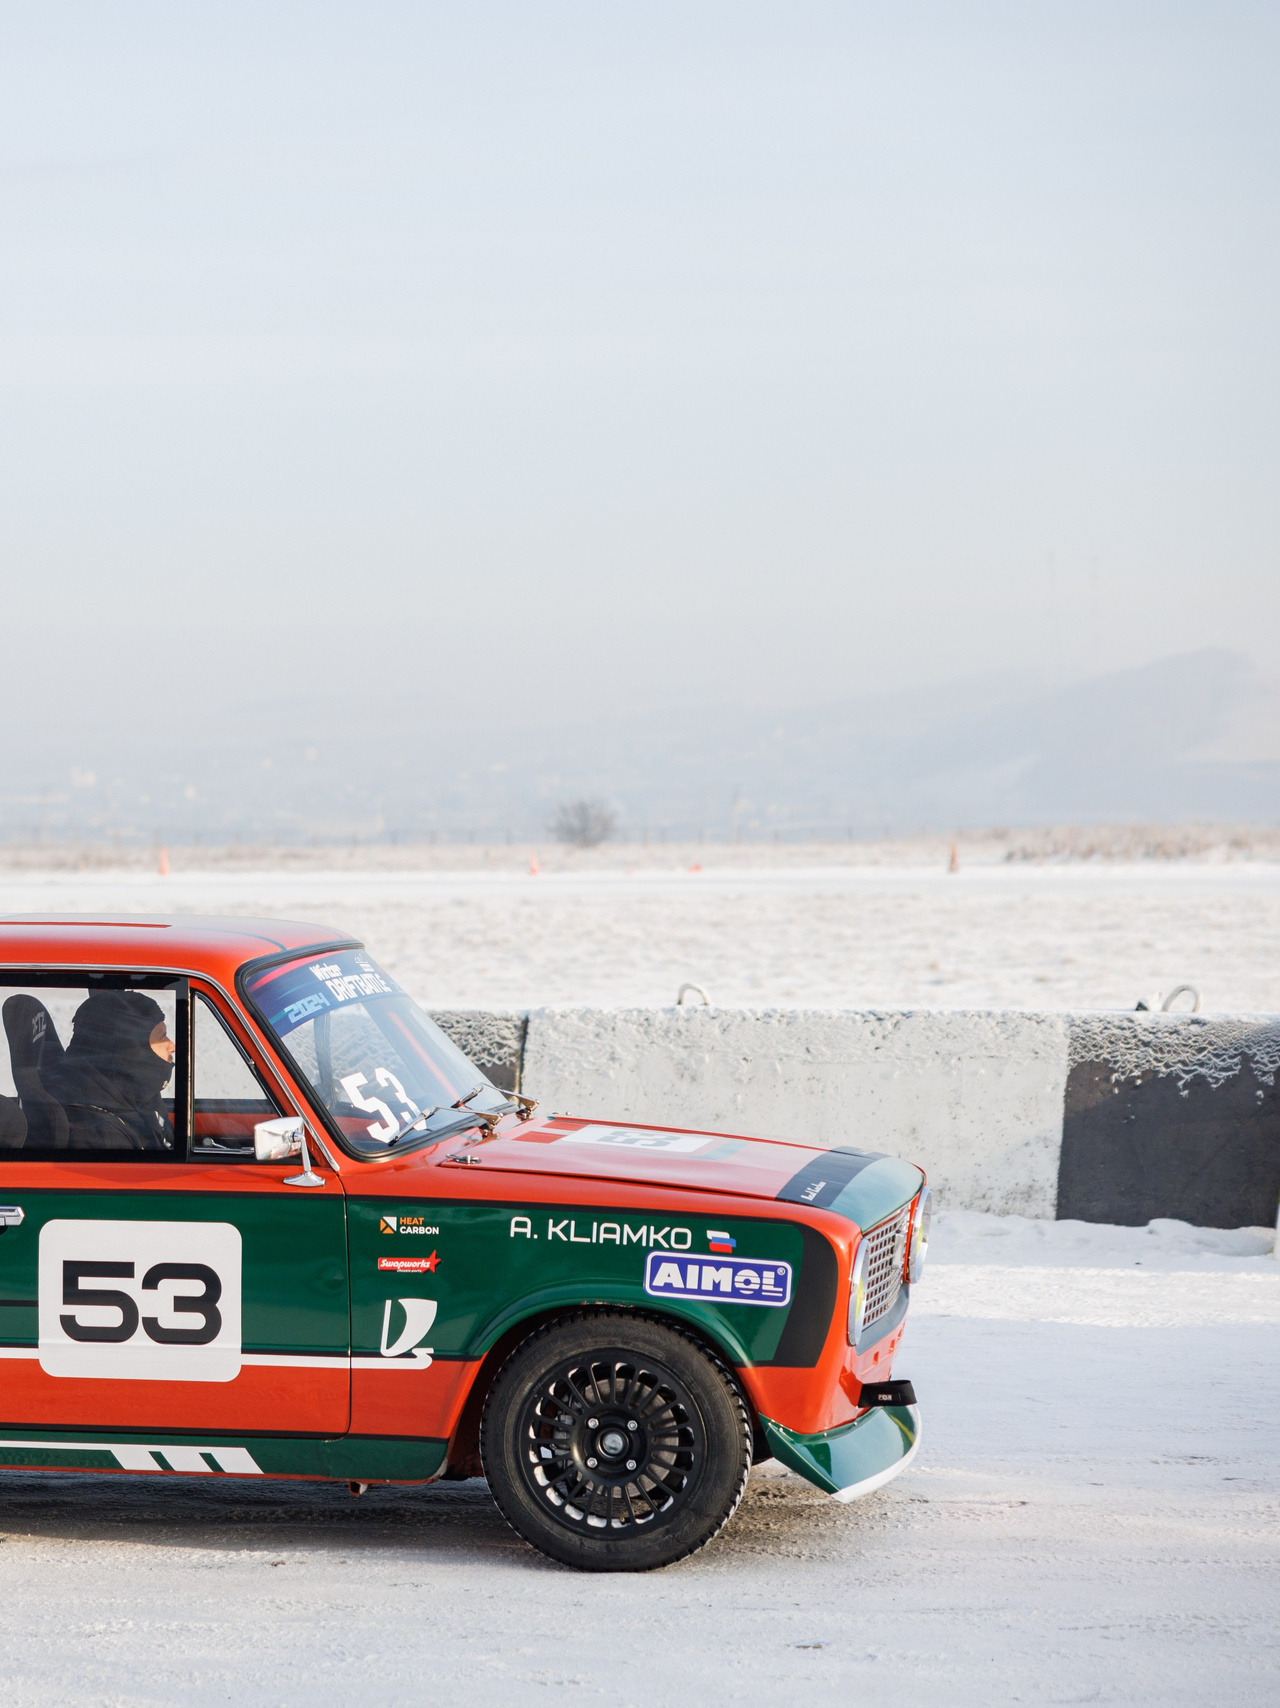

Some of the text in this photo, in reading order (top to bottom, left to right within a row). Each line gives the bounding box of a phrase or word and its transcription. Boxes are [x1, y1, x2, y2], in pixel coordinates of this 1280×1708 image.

[283, 992, 331, 1024] 2024
[340, 1067, 427, 1143] 53
[399, 1226, 439, 1235] CARBON
[400, 1217, 424, 1225] HEAT
[510, 1216, 692, 1250] A. KLIAMKO
[380, 1259, 431, 1269] Swapworks
[59, 1260, 222, 1346] 53
